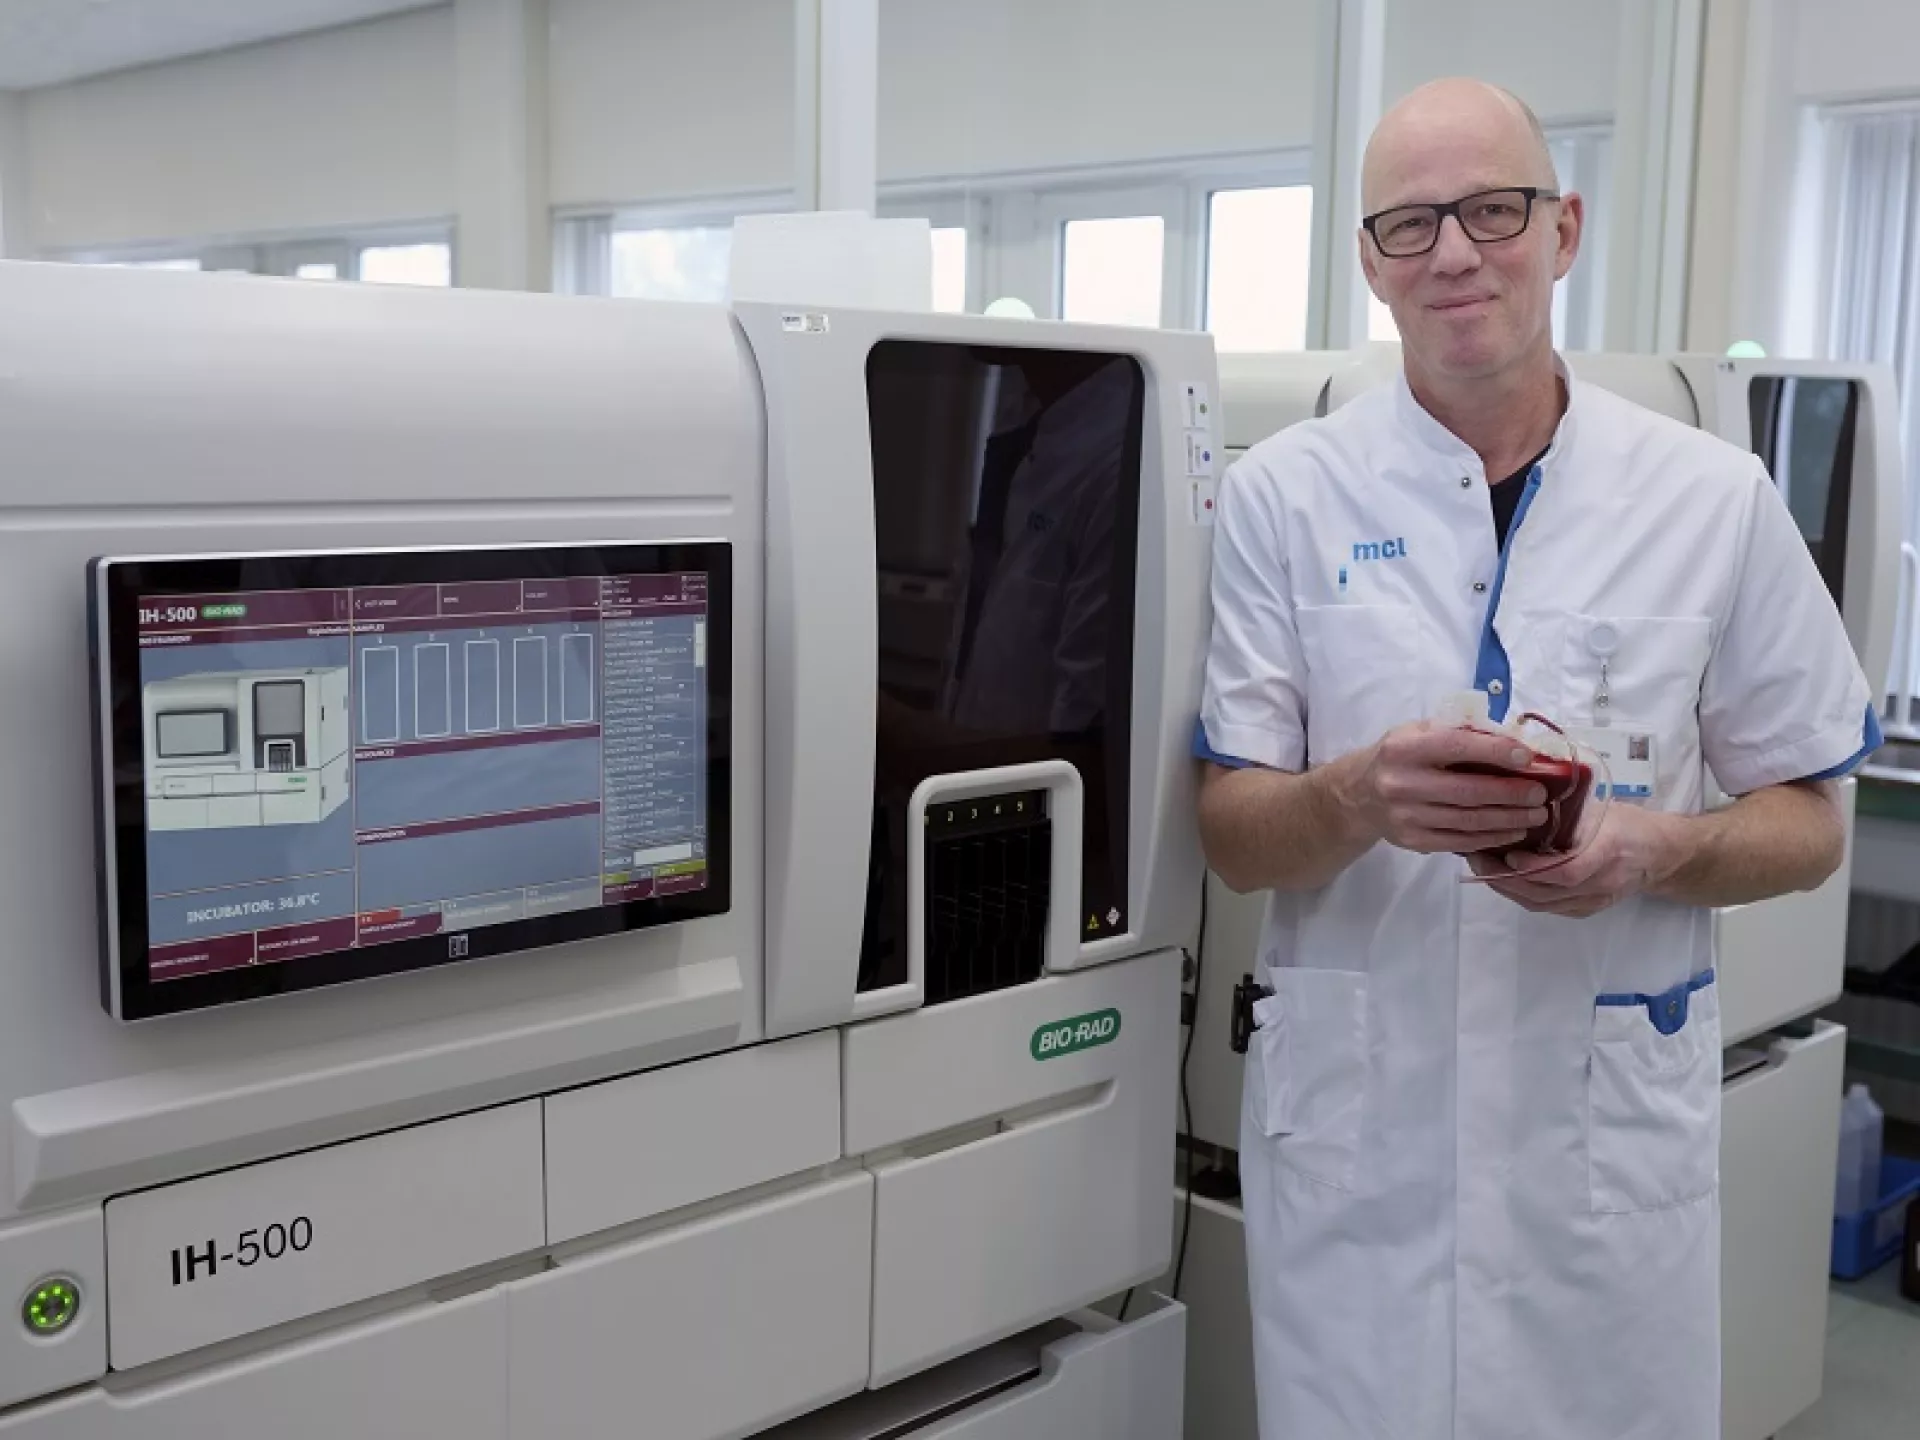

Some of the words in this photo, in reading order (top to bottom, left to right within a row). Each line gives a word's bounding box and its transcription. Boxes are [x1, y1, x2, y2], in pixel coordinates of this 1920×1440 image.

[1353, 537, 1407, 560] mcl
[138, 606, 198, 625] IH-500
[186, 902, 275, 925] INCUBATOR:
[171, 1215, 313, 1287] IH-500
